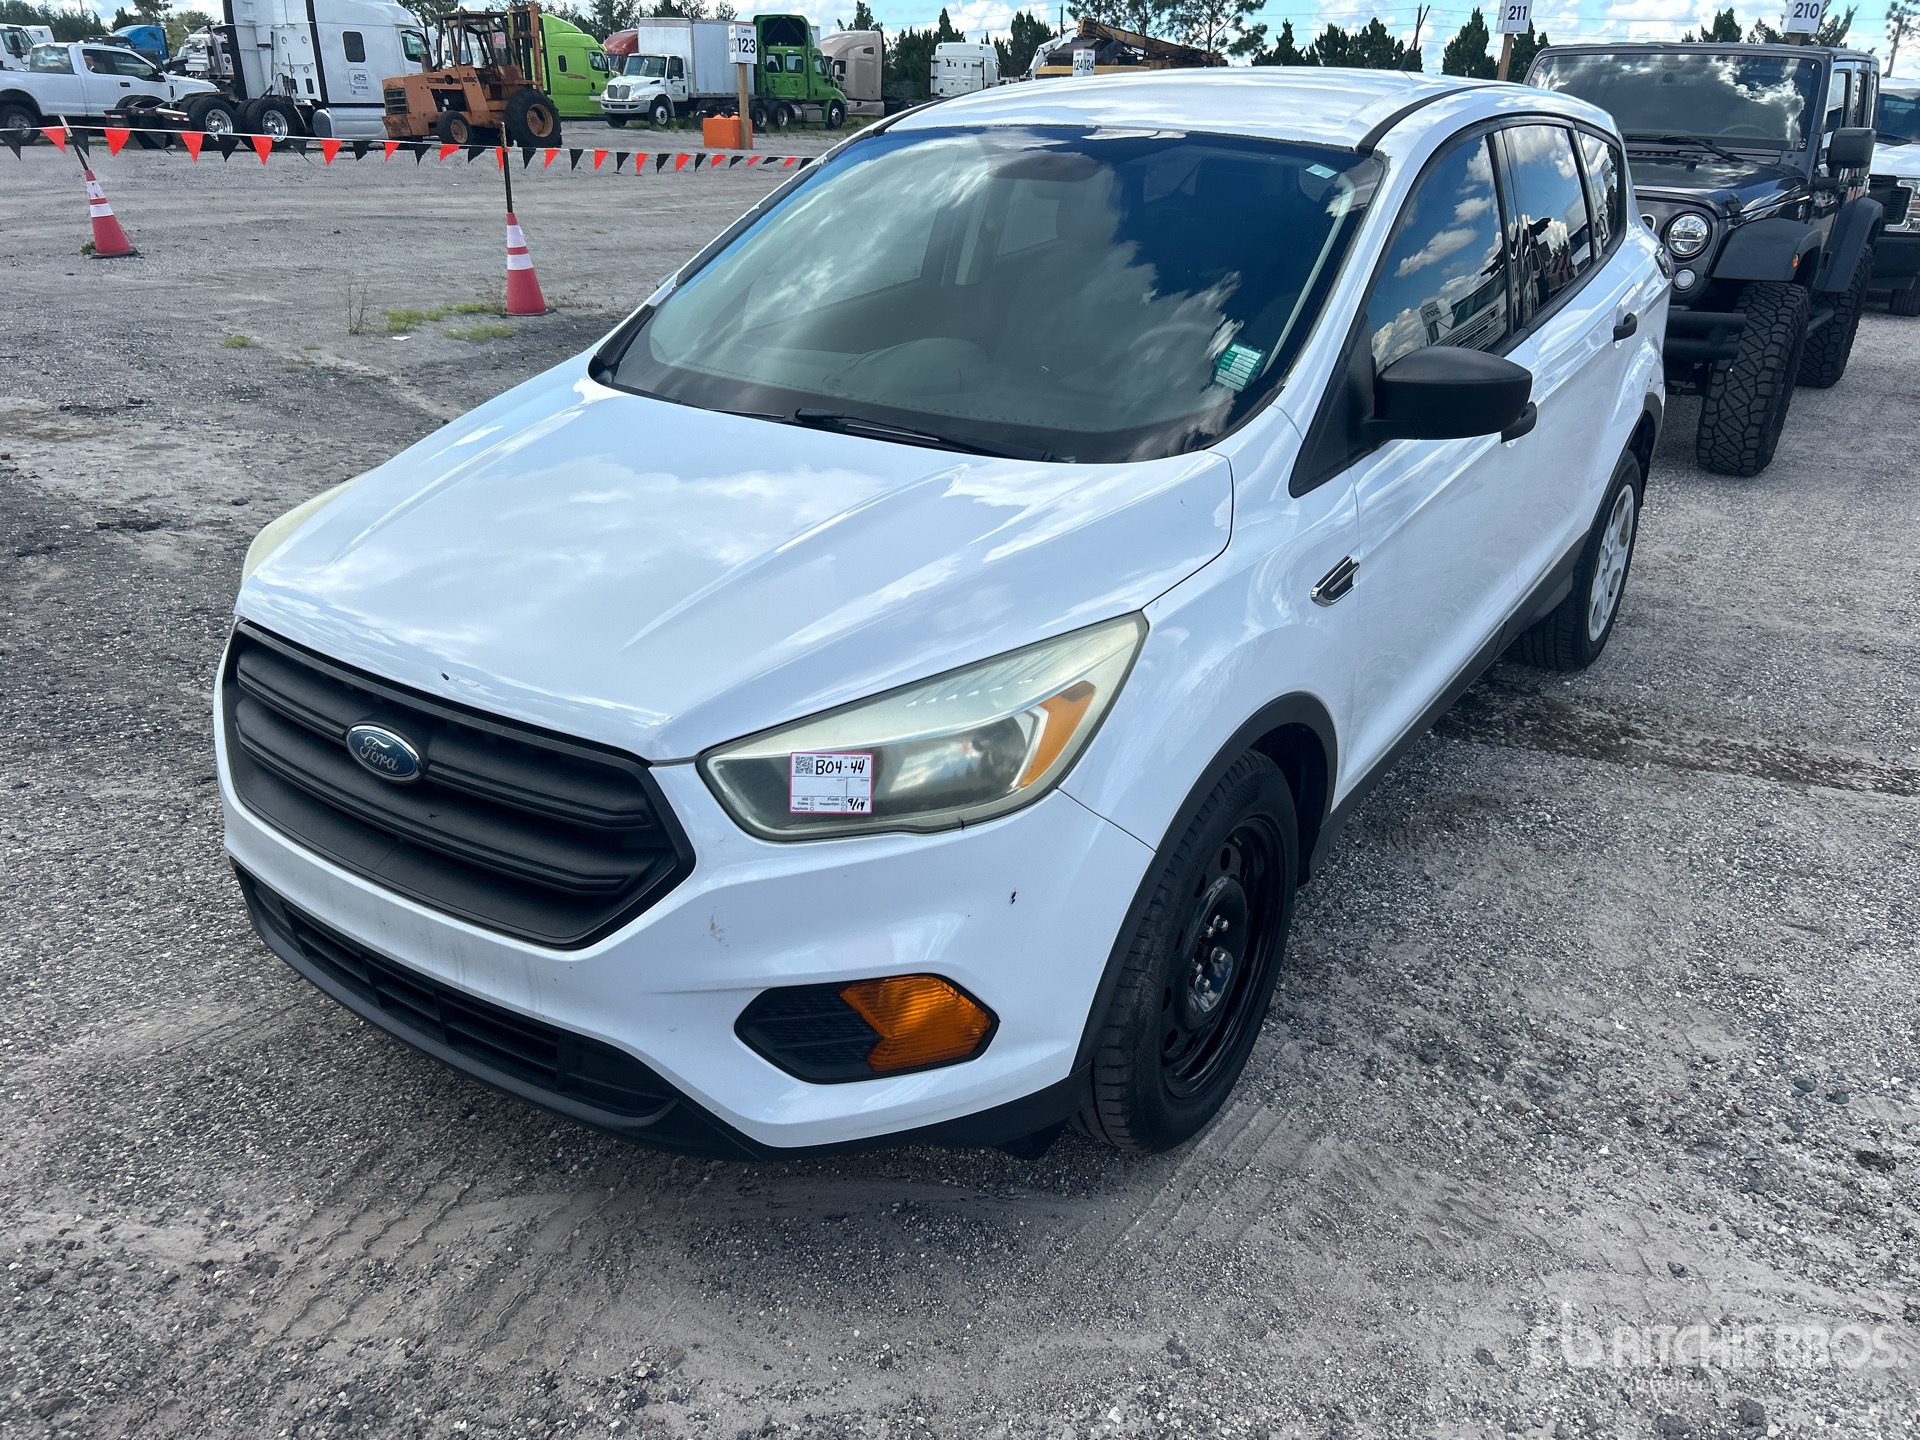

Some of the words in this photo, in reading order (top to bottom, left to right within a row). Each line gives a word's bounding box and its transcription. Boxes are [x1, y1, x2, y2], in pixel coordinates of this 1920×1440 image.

[1507, 5, 1528, 21] 211
[1793, 2, 1820, 19] 210
[736, 37, 756, 54] 123
[360, 736, 399, 771] Ford
